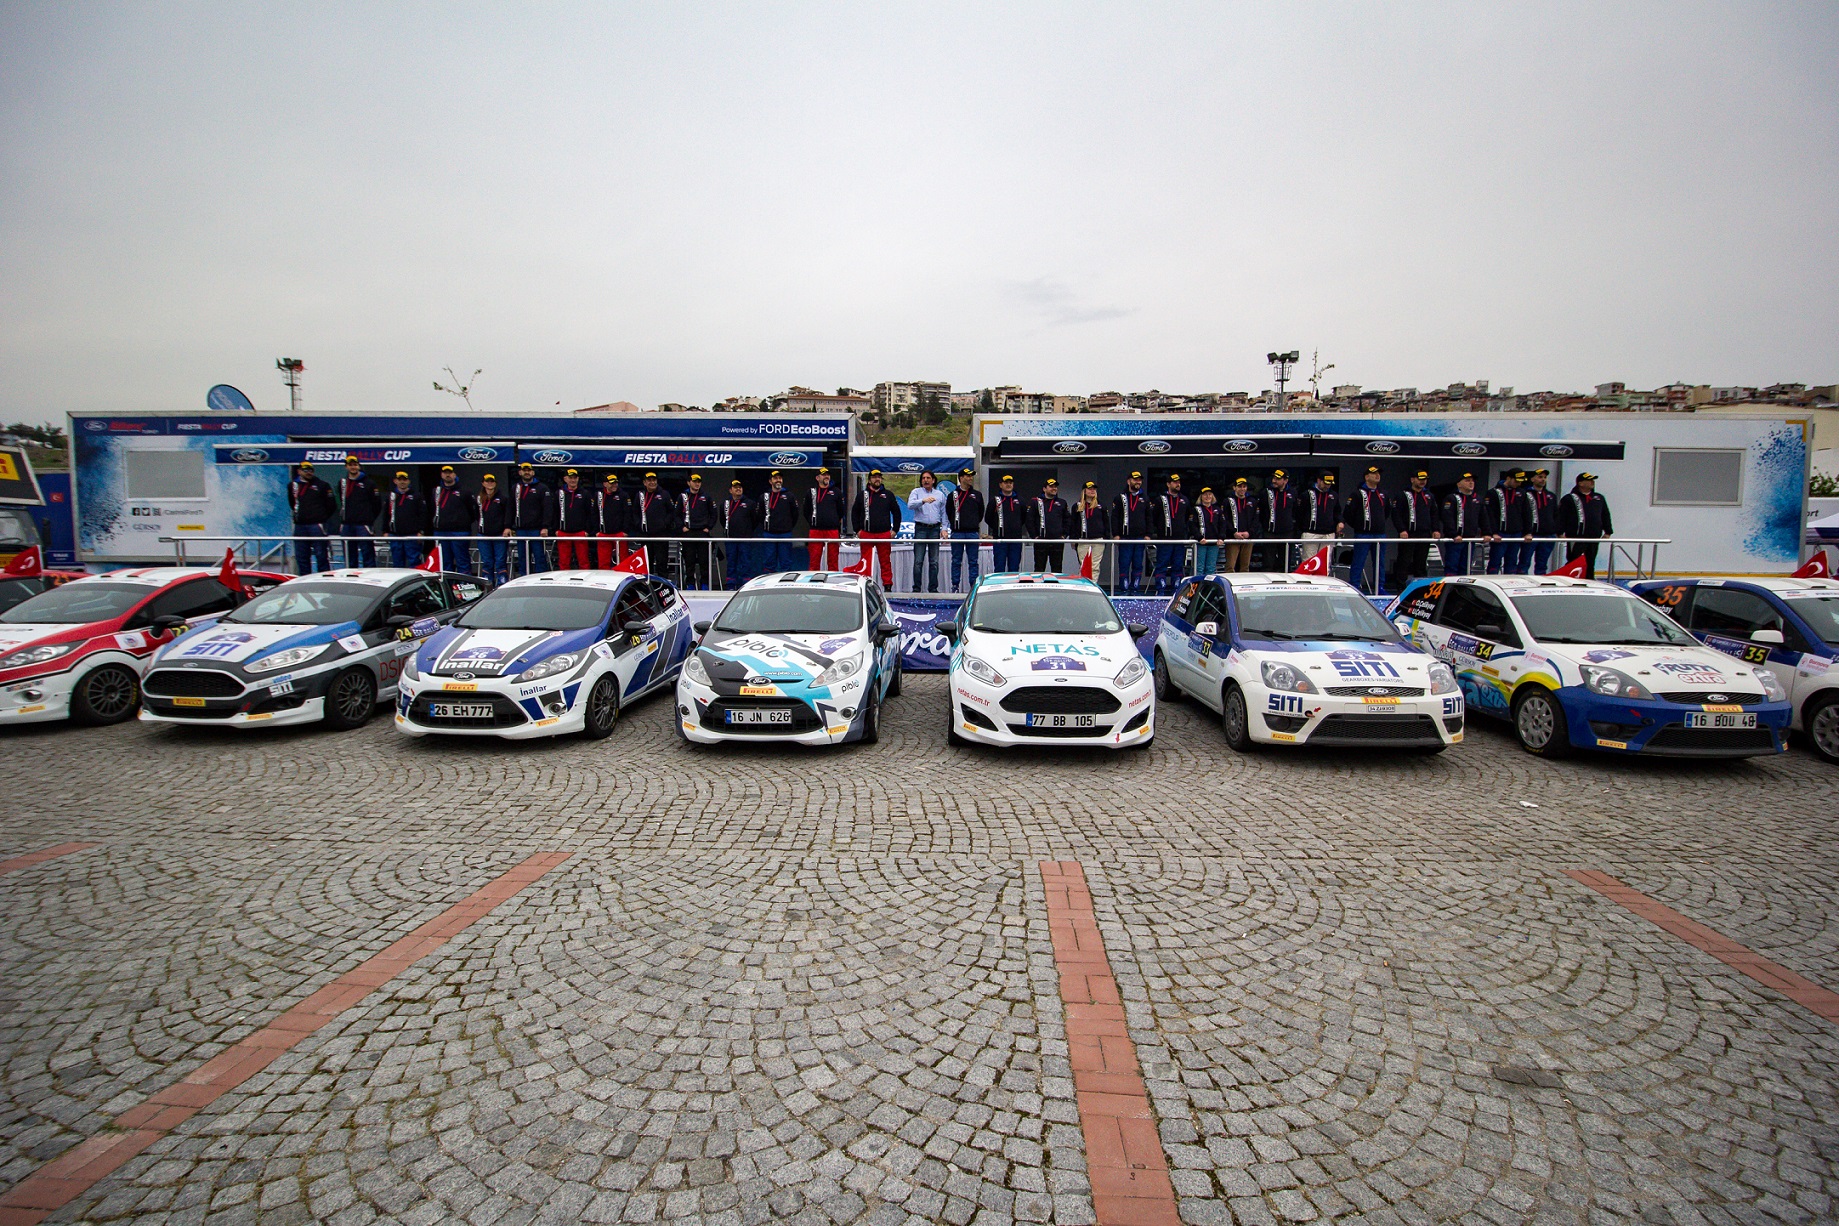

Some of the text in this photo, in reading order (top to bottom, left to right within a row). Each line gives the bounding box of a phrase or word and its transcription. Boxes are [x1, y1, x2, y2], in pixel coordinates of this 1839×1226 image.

[1059, 443, 1081, 452] Ford
[1144, 442, 1165, 451] Ford
[1230, 441, 1252, 450] Ford
[1372, 443, 1394, 452] Ford
[1458, 445, 1480, 454] Ford
[464, 449, 490, 459] Ford
[539, 451, 566, 462] Ford
[1546, 447, 1568, 456] Ford
[774, 453, 801, 464] Ford
[1424, 581, 1446, 599] 34
[1657, 586, 1687, 606] 35
[397, 627, 412, 640] 24
[182, 643, 240, 656] SITI
[1476, 643, 1493, 658] 34
[1744, 646, 1766, 662] 35
[1051, 662, 1067, 670] 31
[1331, 661, 1400, 677] SITI
[1679, 672, 1725, 684] extra
[269, 682, 294, 697] SITI
[957, 687, 990, 707] netas.com.tr
[1268, 693, 1304, 713] SITI
[435, 705, 491, 716] 26 EH 777
[732, 711, 790, 721] 16 JN 626
[1033, 715, 1093, 726] 77 BB 105
[1694, 715, 1707, 726] 16
[1600, 740, 1625, 748] PIRELLI
